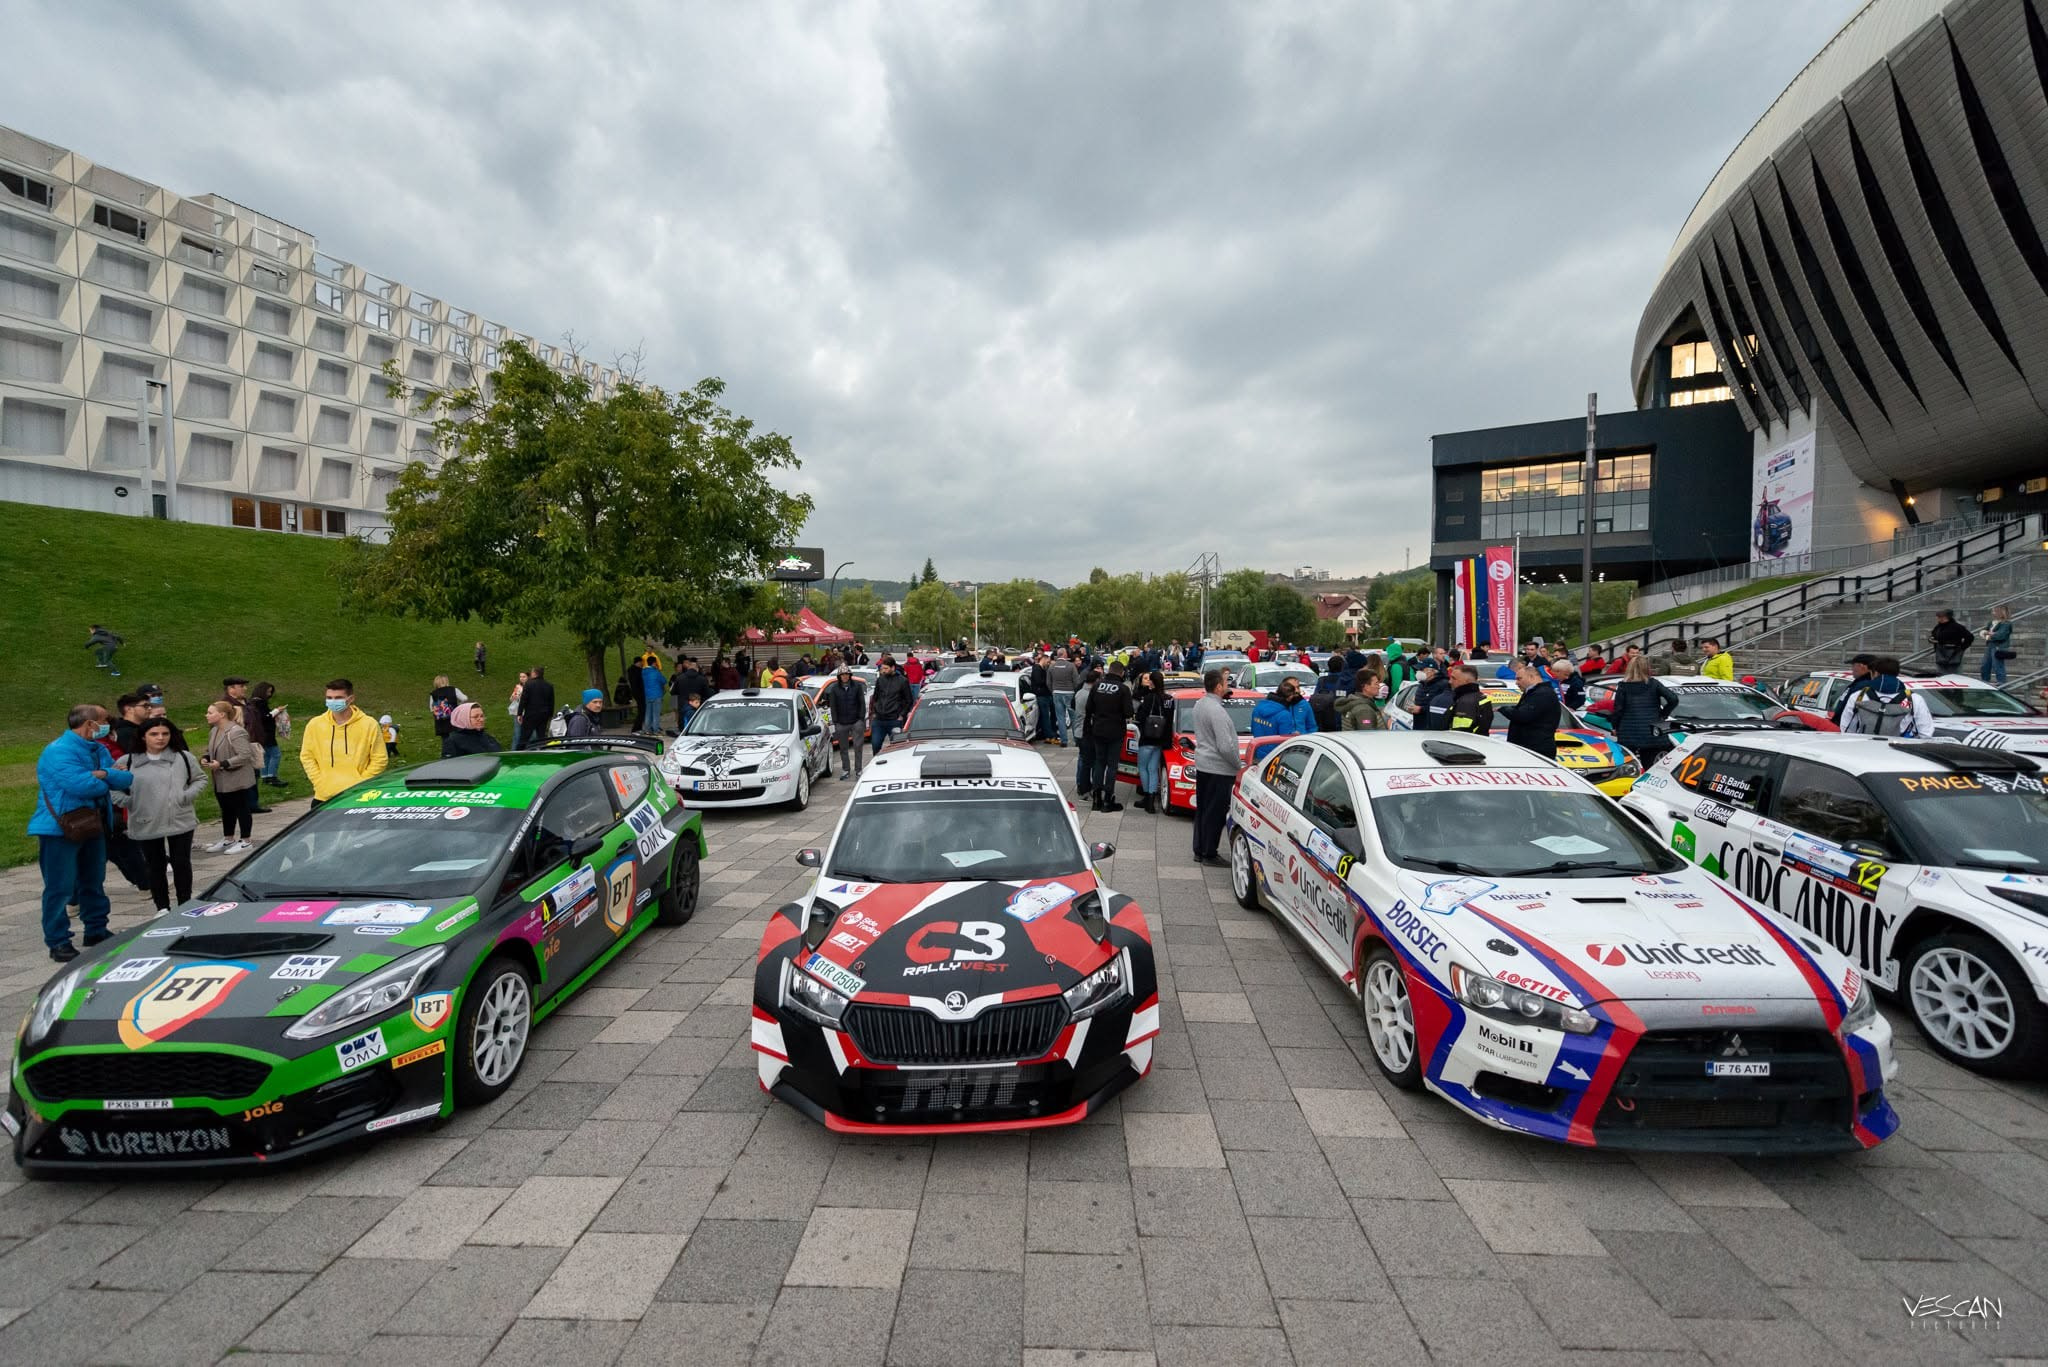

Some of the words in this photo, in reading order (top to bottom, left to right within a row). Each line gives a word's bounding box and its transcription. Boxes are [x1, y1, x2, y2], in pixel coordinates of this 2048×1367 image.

[1097, 682, 1119, 692] DTO
[1266, 756, 1280, 782] 6
[1429, 769, 1570, 788] GENERALI
[1678, 755, 1707, 786] 12
[707, 781, 720, 789] 185
[722, 781, 738, 789] MAM
[871, 779, 1048, 793] CBRALLYVEST
[1715, 784, 1745, 800] B.Iancu
[1720, 774, 1750, 791] S.Barbu
[1899, 775, 1983, 792] PAVEL
[381, 790, 502, 800] LORENZON
[344, 806, 402, 815] NAPOCA
[1709, 812, 1729, 824] STONE
[1713, 806, 1734, 817] ADAM
[640, 823, 667, 858] OMV
[1338, 855, 1354, 878] 6
[1858, 861, 1887, 891] 12
[613, 873, 632, 908] BT
[1299, 867, 1349, 945] UniCredit
[905, 921, 1006, 961] CB
[1385, 898, 1449, 965] BORSEC
[1623, 938, 1777, 967] UniCredit
[277, 967, 326, 979] OMV
[814, 960, 836, 978] 01R
[832, 971, 861, 994] 0508
[902, 962, 1008, 977] RALLYVEST
[1644, 969, 1702, 983] Leasing
[152, 977, 226, 1002] BT
[1496, 969, 1571, 1002] LOCTITE
[421, 999, 445, 1014] BT
[1479, 1024, 1516, 1049] Mobil
[344, 1044, 381, 1069] OMV
[397, 1043, 441, 1066] PIRELLI
[1477, 1043, 1495, 1056] STAR
[1495, 1052, 1538, 1069] LUBRICANTS
[1715, 1064, 1725, 1074] IF
[1728, 1064, 1742, 1074] 76
[1744, 1064, 1768, 1074] ATM
[107, 1101, 138, 1109] PX69
[144, 1100, 170, 1108] EFR
[92, 1128, 231, 1155] LORENZON
